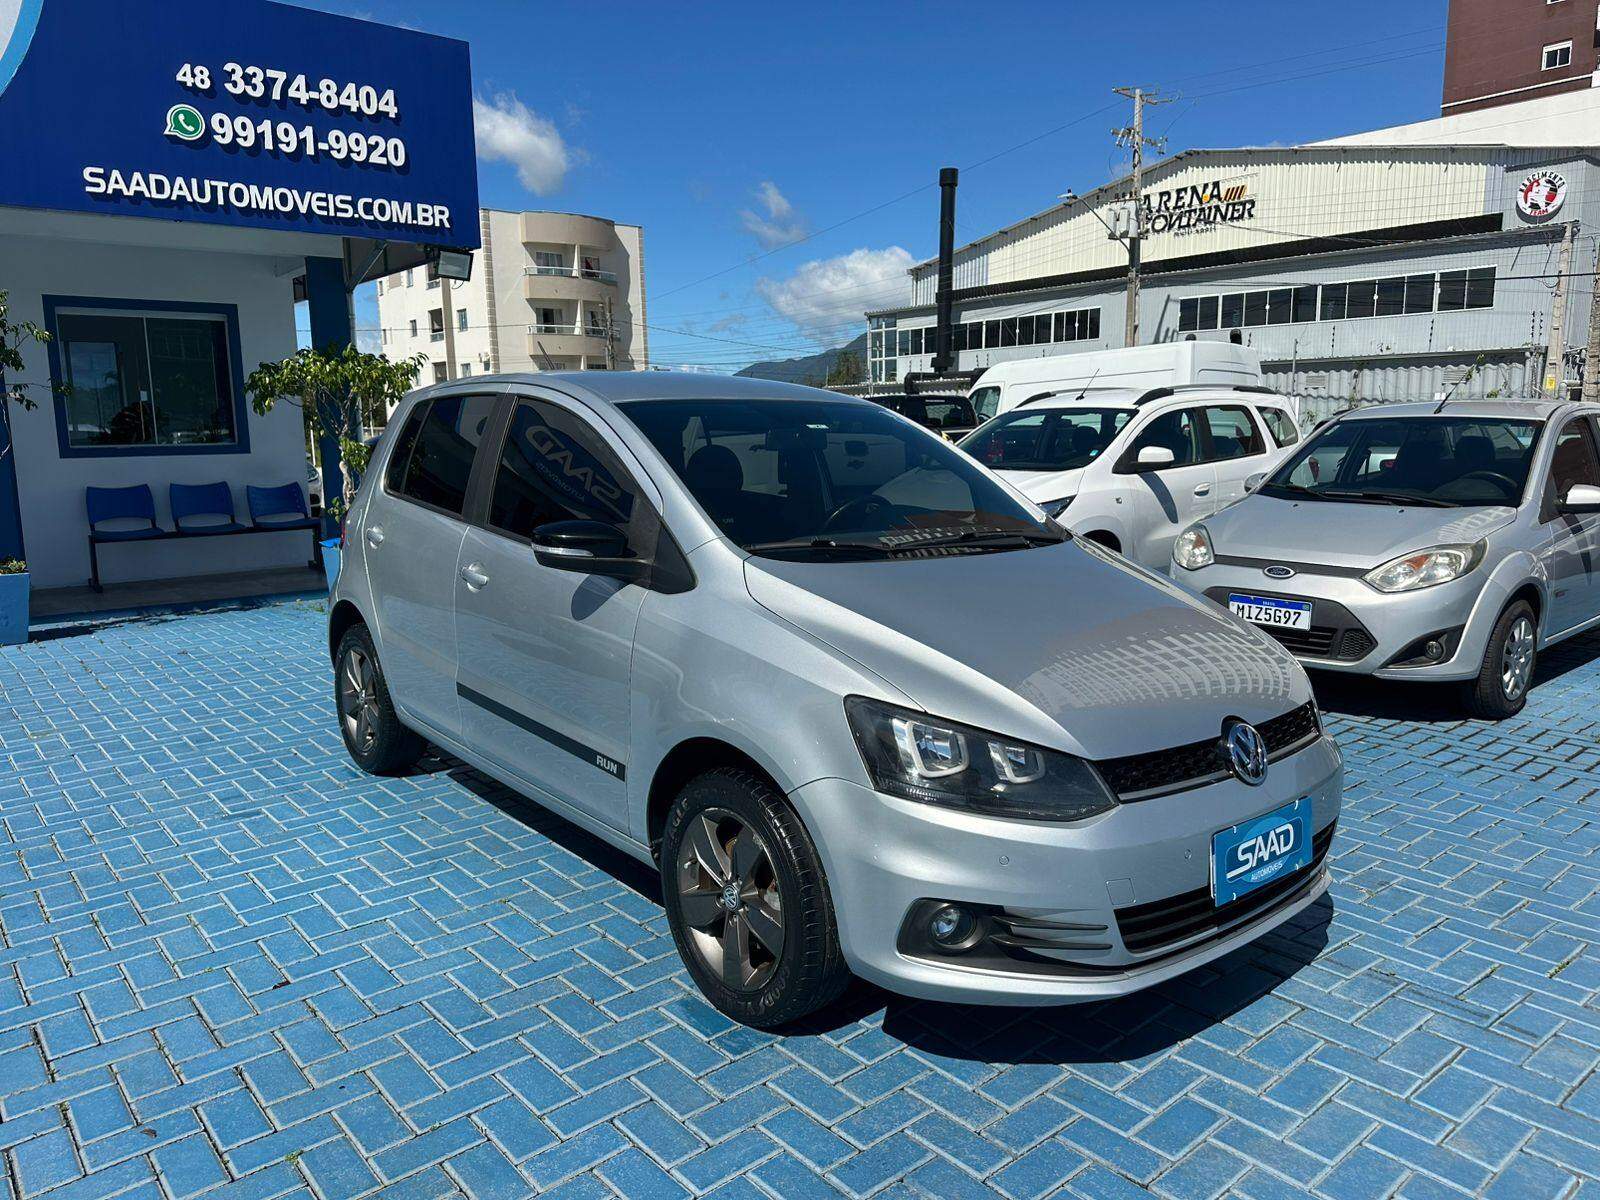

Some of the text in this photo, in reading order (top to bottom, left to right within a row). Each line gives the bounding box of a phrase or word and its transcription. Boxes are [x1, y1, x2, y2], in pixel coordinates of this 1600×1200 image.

[176, 62, 398, 118] 48 3374-8404
[211, 113, 405, 166] 99191-9920
[83, 167, 451, 228] SAADAUTOMOVEIS.COM.BR
[1143, 181, 1223, 213] ARENA
[1236, 604, 1302, 625] MIZ5G97
[596, 755, 618, 774] RUN
[1226, 822, 1295, 880] SAAD
